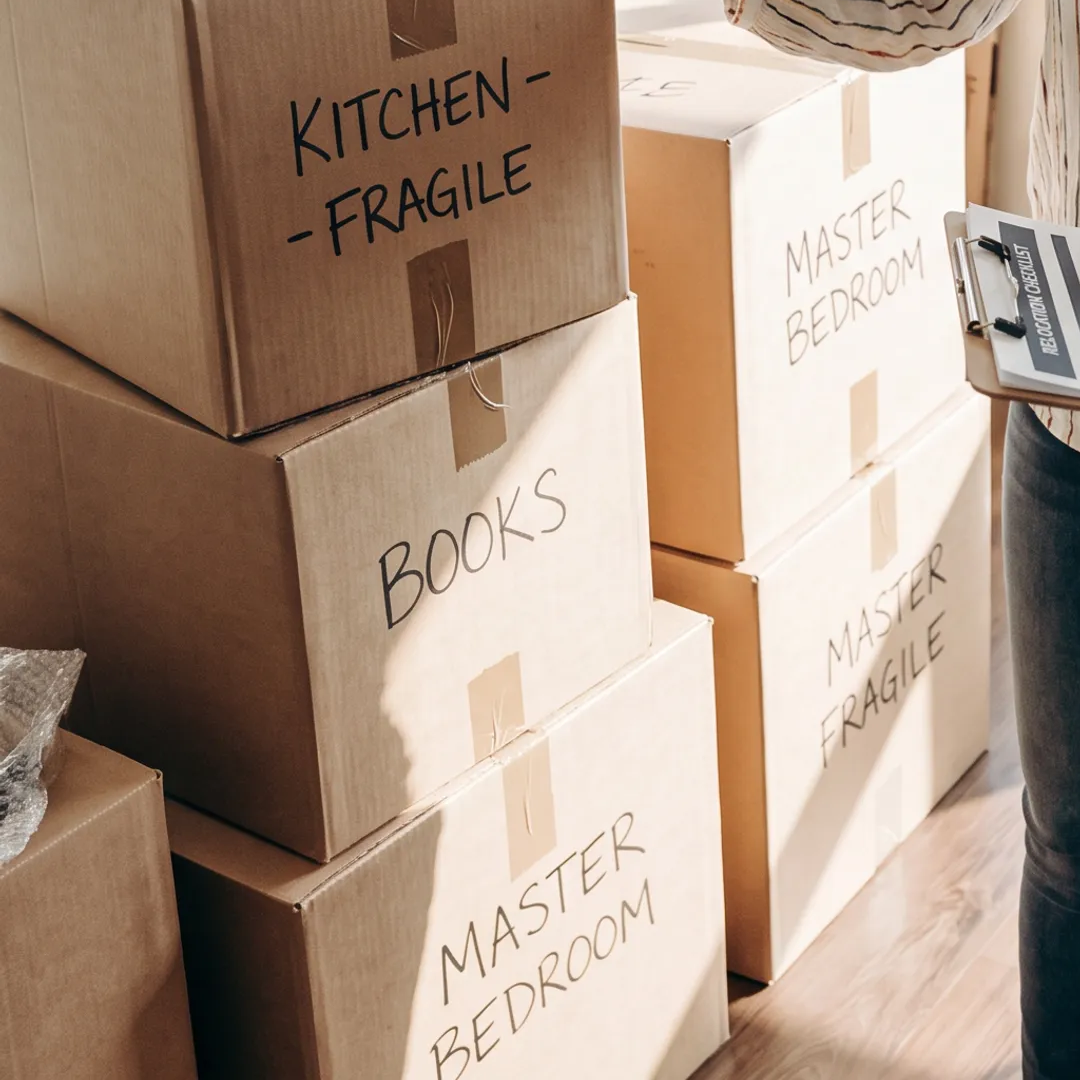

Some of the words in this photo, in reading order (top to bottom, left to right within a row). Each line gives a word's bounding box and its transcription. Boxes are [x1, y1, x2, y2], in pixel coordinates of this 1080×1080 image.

[786, 236, 924, 366] BEDROOM
[787, 179, 911, 298] MASTER
[1013, 243, 1041, 295] CHECKLIST
[1026, 294, 1059, 356] RELOCATION
[379, 468, 566, 629] BOOKS
[828, 542, 947, 688] MASTER
[820, 610, 946, 769] FRAGILE
[430, 877, 655, 1080] BEDROOM
[441, 812, 646, 1006] MASTER
